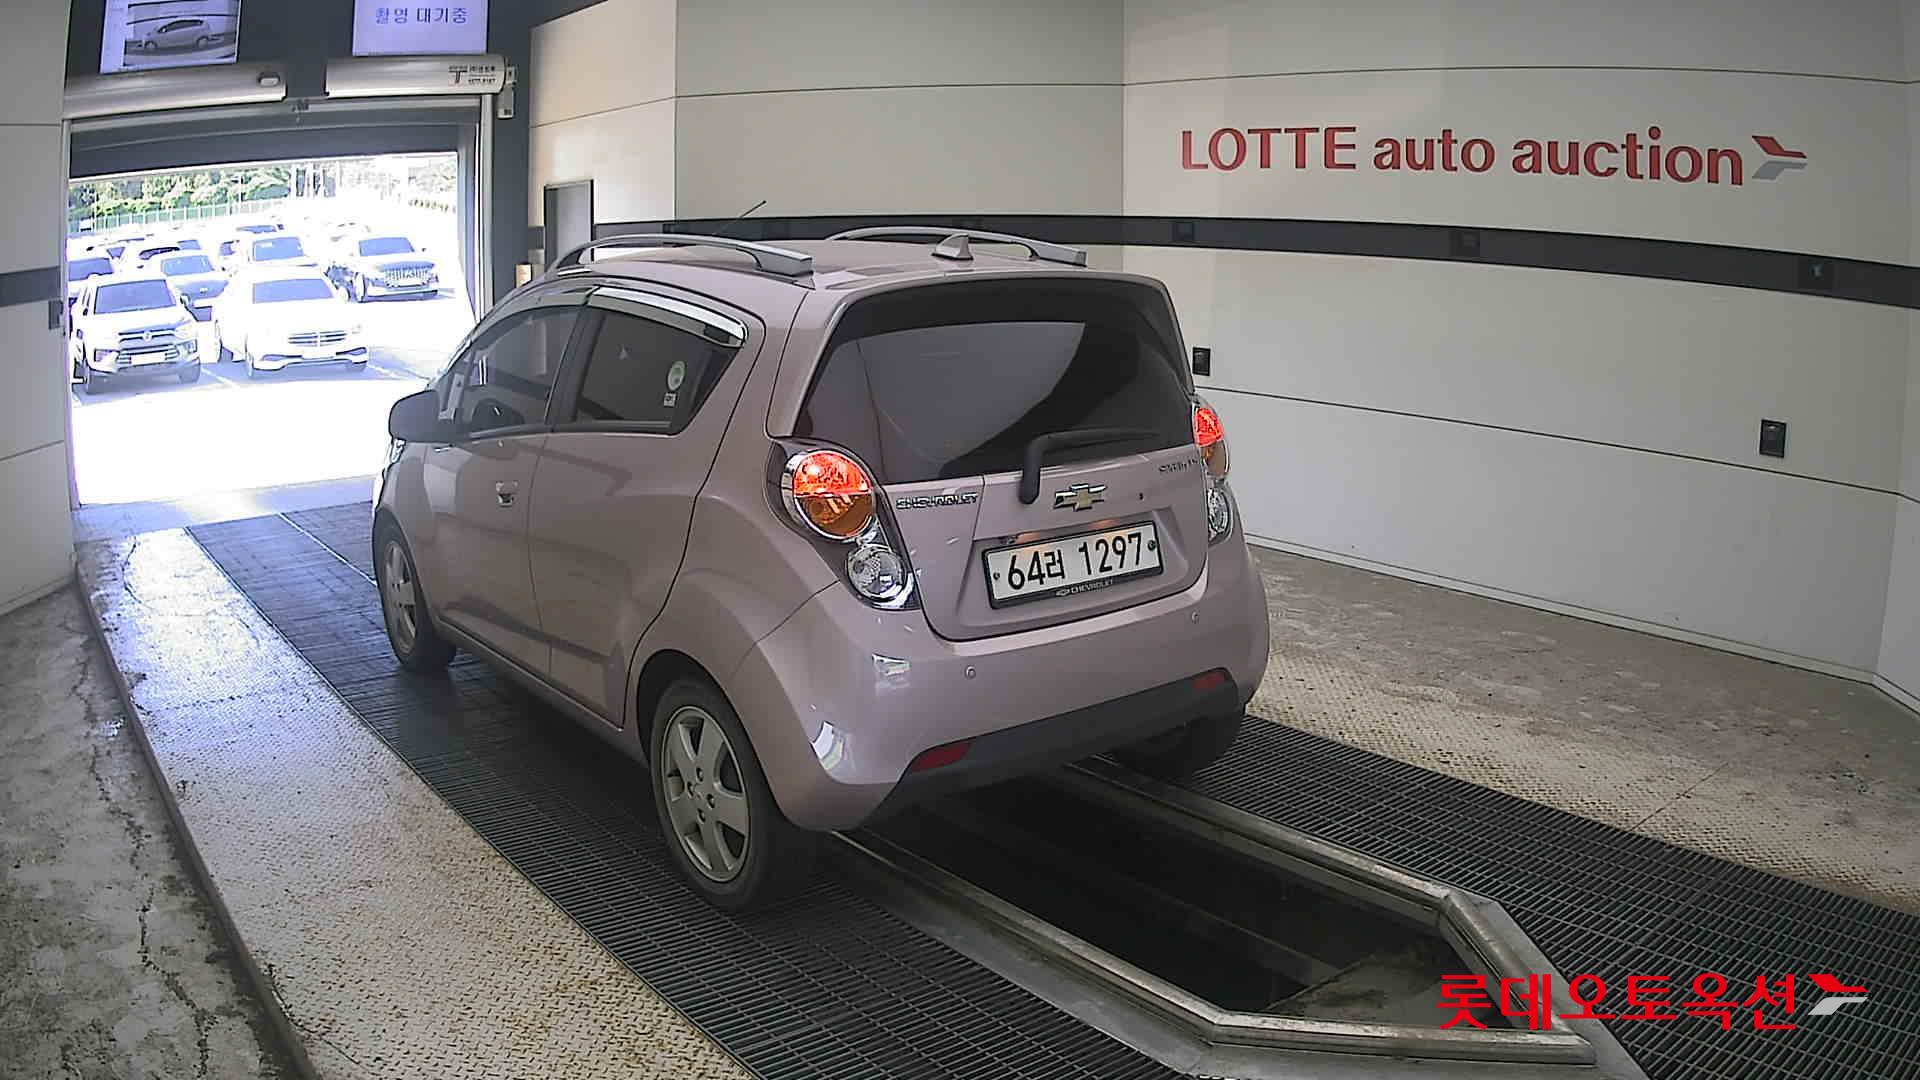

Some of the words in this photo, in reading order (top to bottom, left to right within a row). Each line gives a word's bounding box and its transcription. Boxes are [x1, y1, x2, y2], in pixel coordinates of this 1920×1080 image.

[416, 7, 467, 24] 대기중
[1182, 127, 1356, 171] LOTTE
[1373, 129, 1495, 172] auto
[1512, 126, 1743, 186] auction
[1008, 549, 1065, 590] 64러
[1079, 532, 1142, 577] 1297
